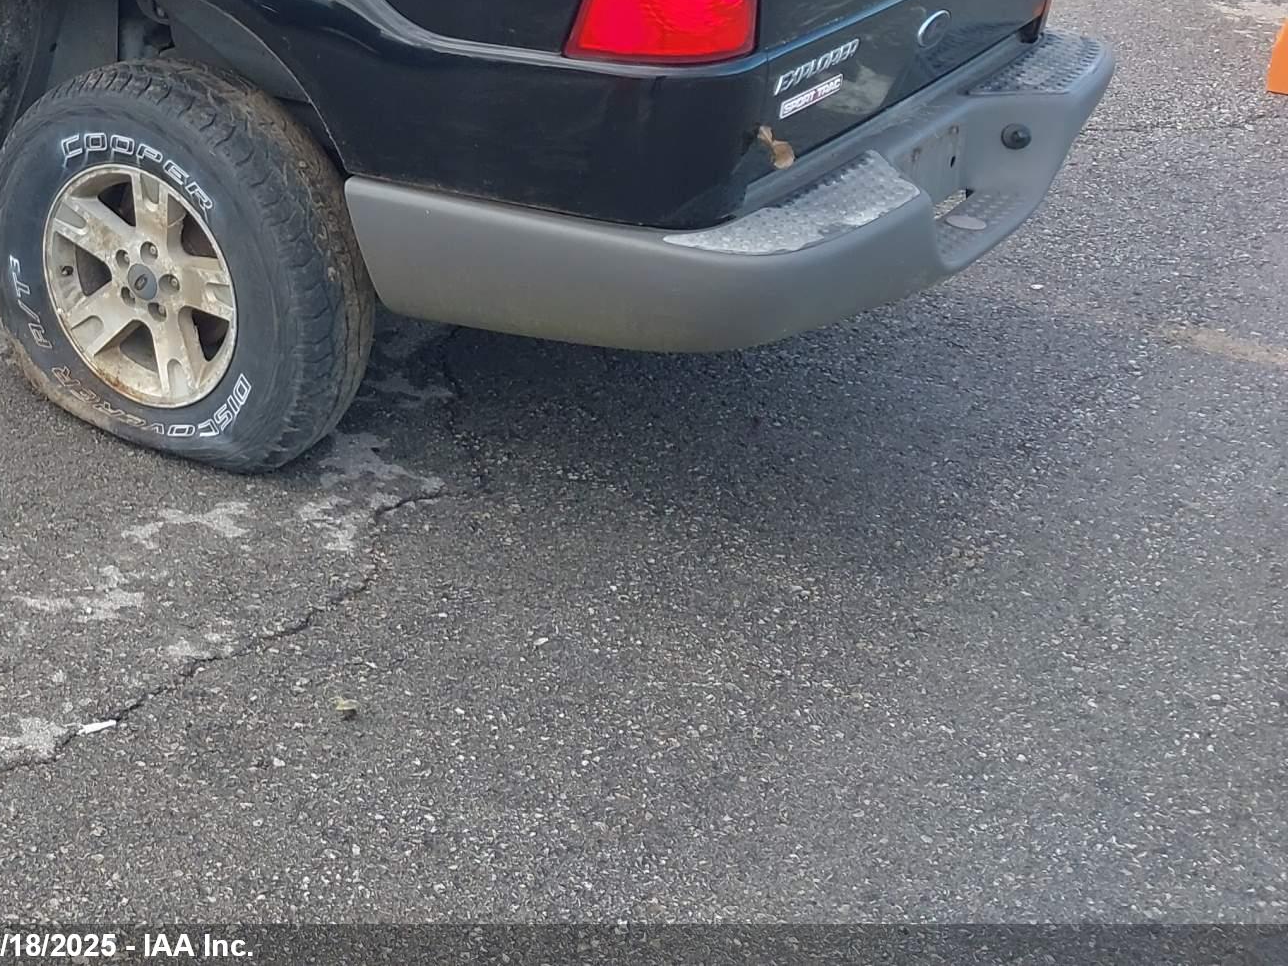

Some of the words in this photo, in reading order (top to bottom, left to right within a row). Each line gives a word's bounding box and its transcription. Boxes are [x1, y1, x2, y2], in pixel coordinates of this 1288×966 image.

[774, 37, 861, 96] EXPLORER
[783, 89, 816, 115] SPORT
[817, 76, 842, 100] TRAC
[60, 132, 214, 211] COOPER
